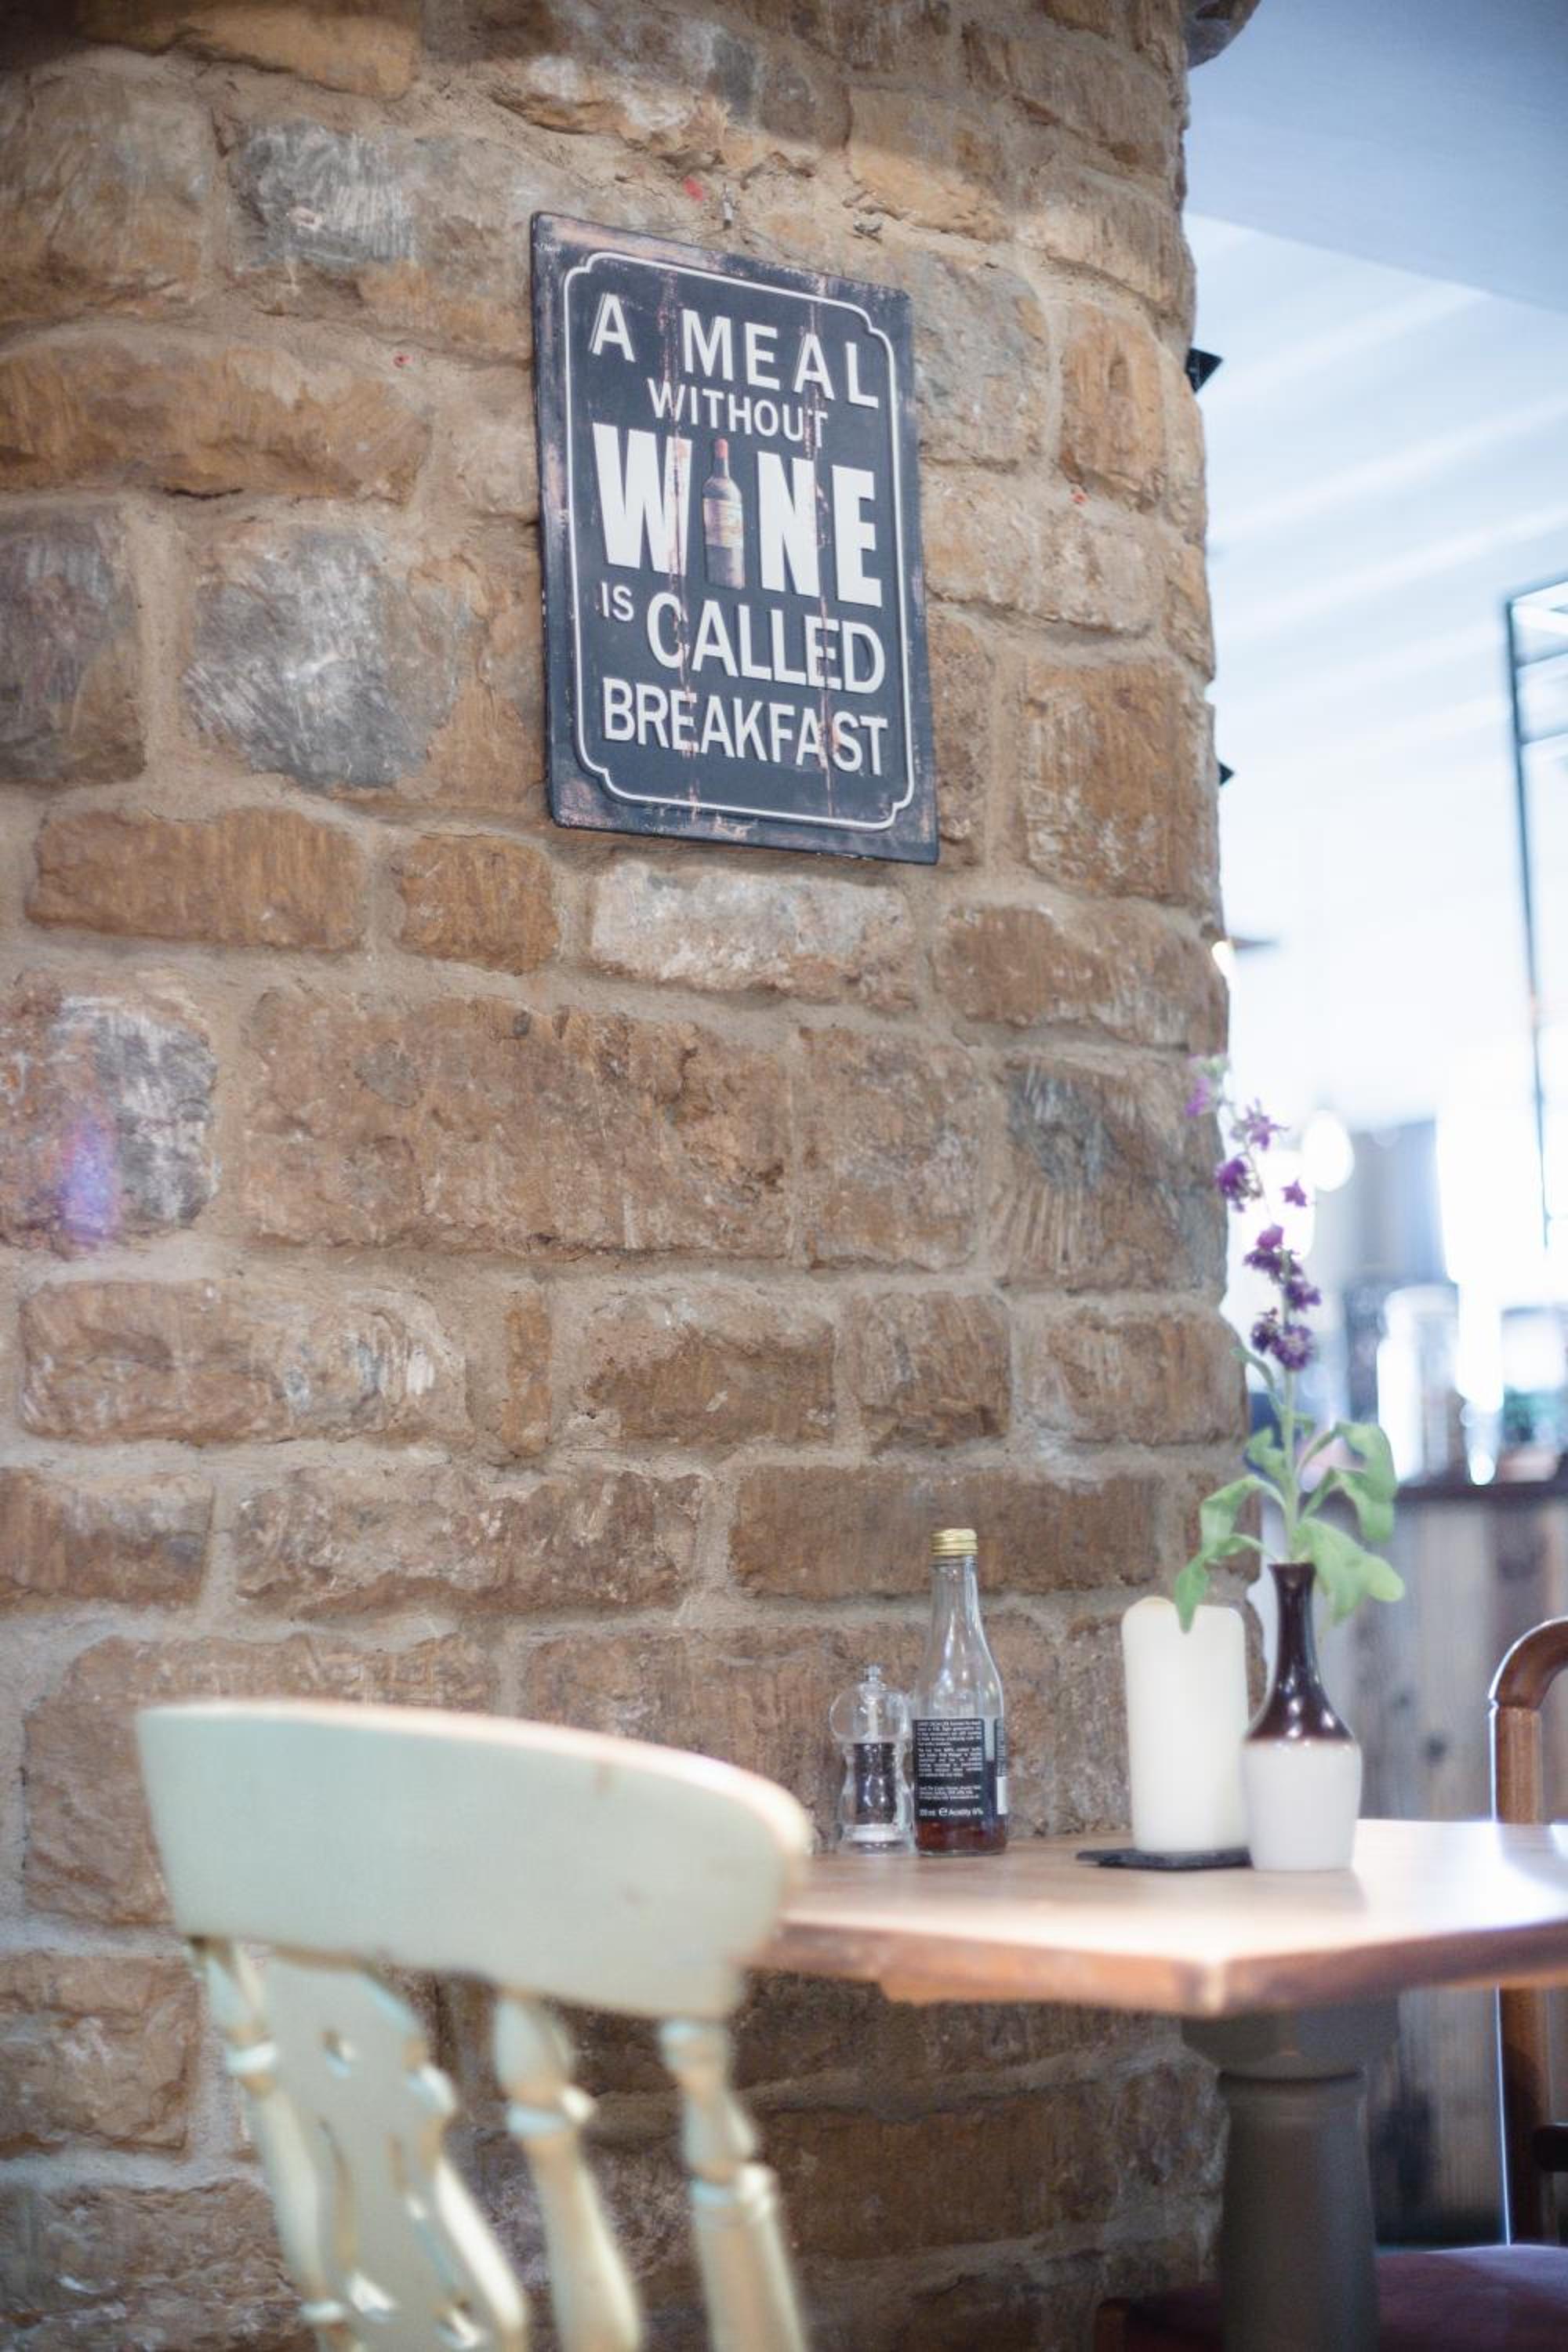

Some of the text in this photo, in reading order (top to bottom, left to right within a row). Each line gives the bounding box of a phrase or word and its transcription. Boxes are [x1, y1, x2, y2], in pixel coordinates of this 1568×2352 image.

[589, 292, 880, 409] A MEAL
[647, 377, 829, 448] WITHOUT
[592, 422, 883, 608] WINE
[601, 581, 886, 694] IS CALLED
[602, 677, 888, 776] BREAKFAST
